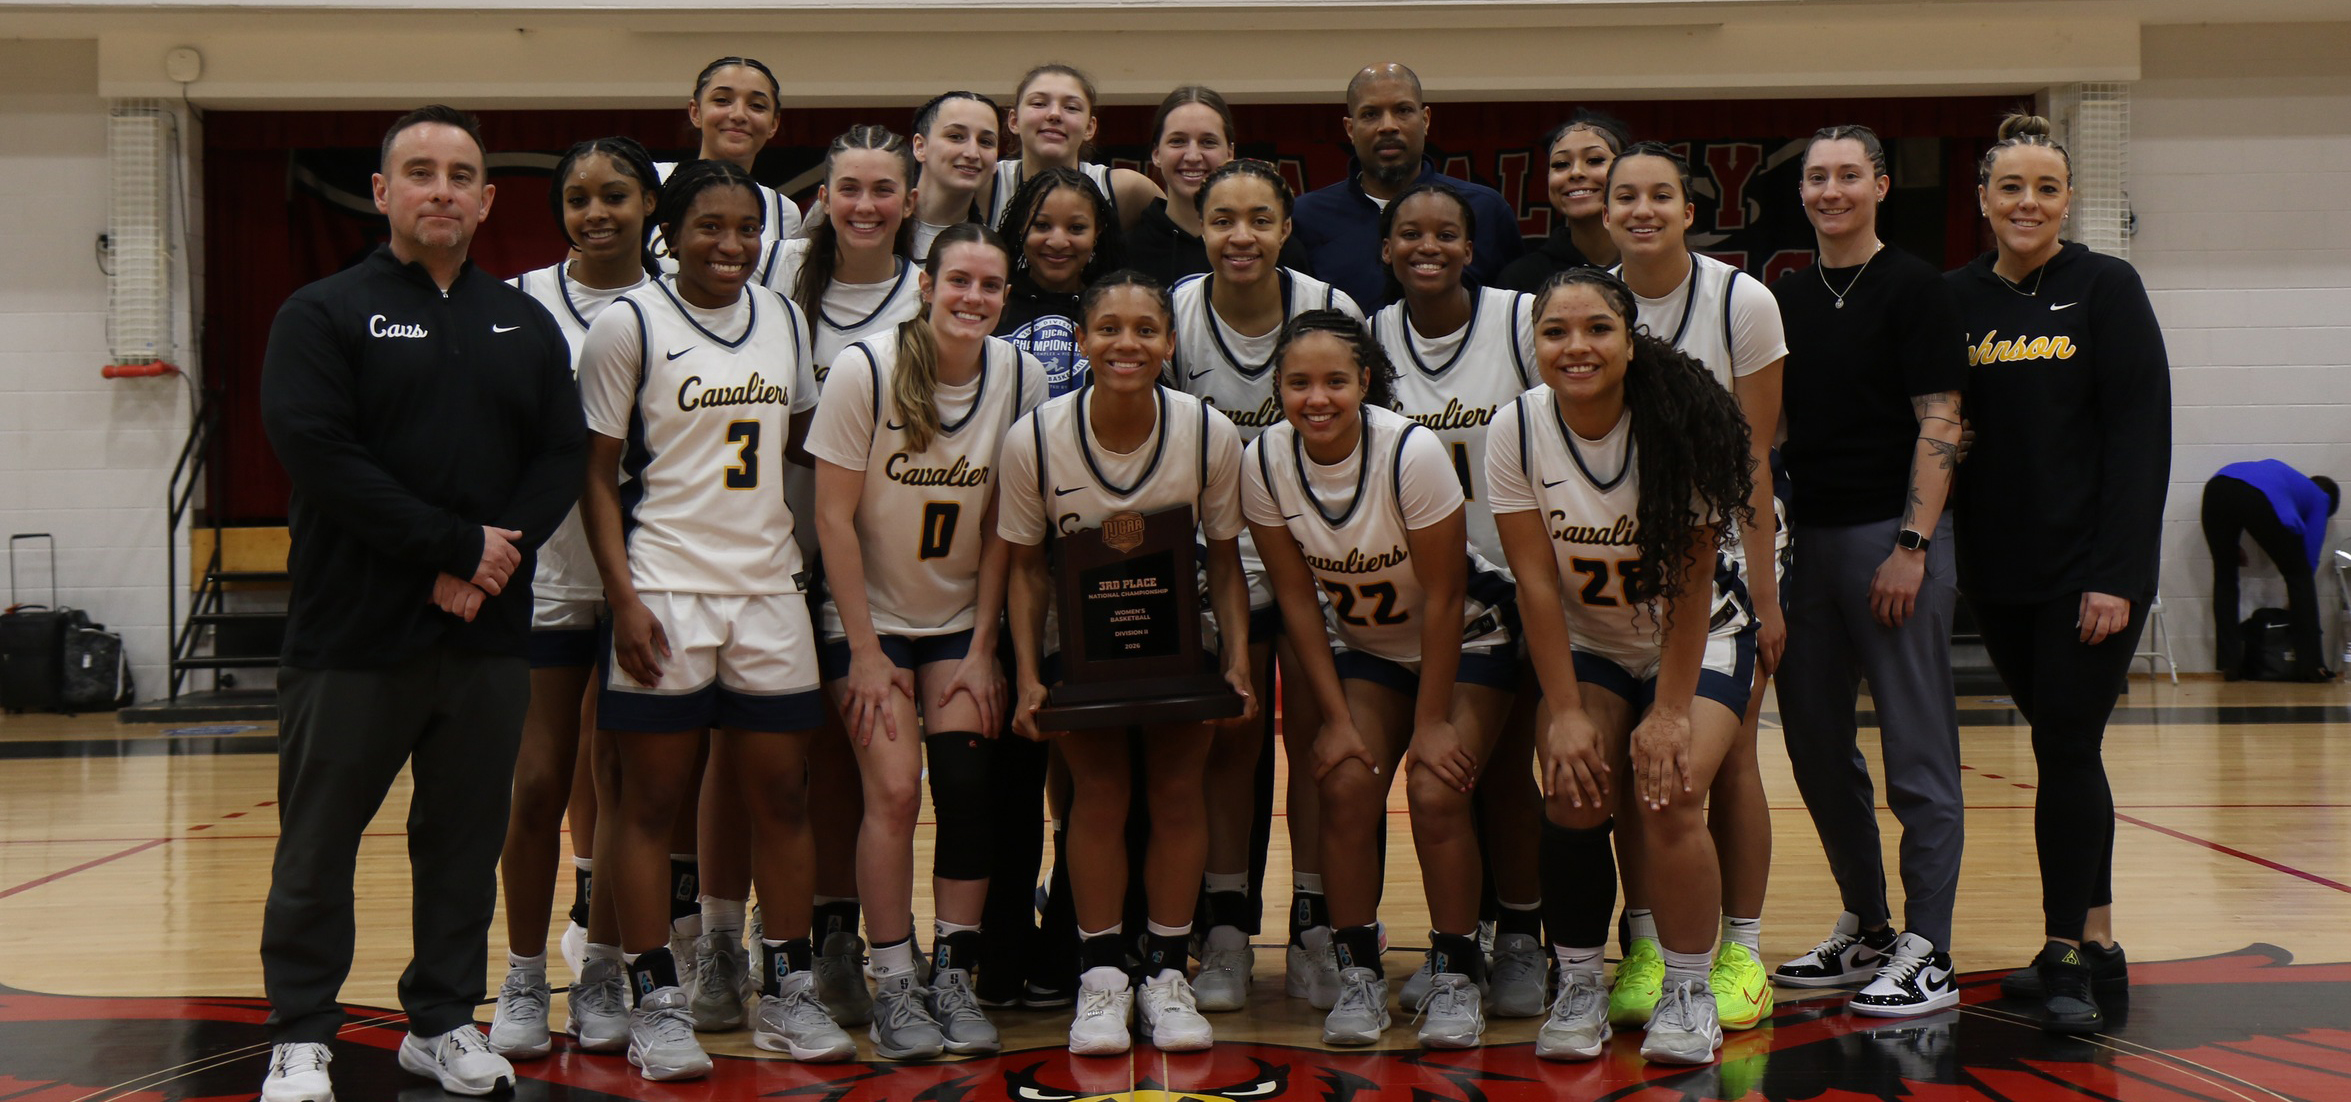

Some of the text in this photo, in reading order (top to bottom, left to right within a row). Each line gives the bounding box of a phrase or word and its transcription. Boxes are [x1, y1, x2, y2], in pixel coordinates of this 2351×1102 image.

[369, 314, 428, 338] Cavs
[1041, 329, 1069, 340] NJCAA
[724, 418, 760, 490] 3
[885, 452, 990, 487] Cavalier
[918, 500, 961, 562] 0
[1103, 519, 1144, 542] NJCAA
[1550, 509, 1641, 546] Cavali
[1296, 539, 1408, 574] avaliers
[1088, 588, 1169, 600] NATIONAL CHAMPIONSHIP
[1099, 577, 1157, 591] 3RD PLACE
[1114, 608, 1146, 616] WOMEN'S
[1319, 576, 1410, 628] 22
[1110, 614, 1151, 623] BASKETBALL
